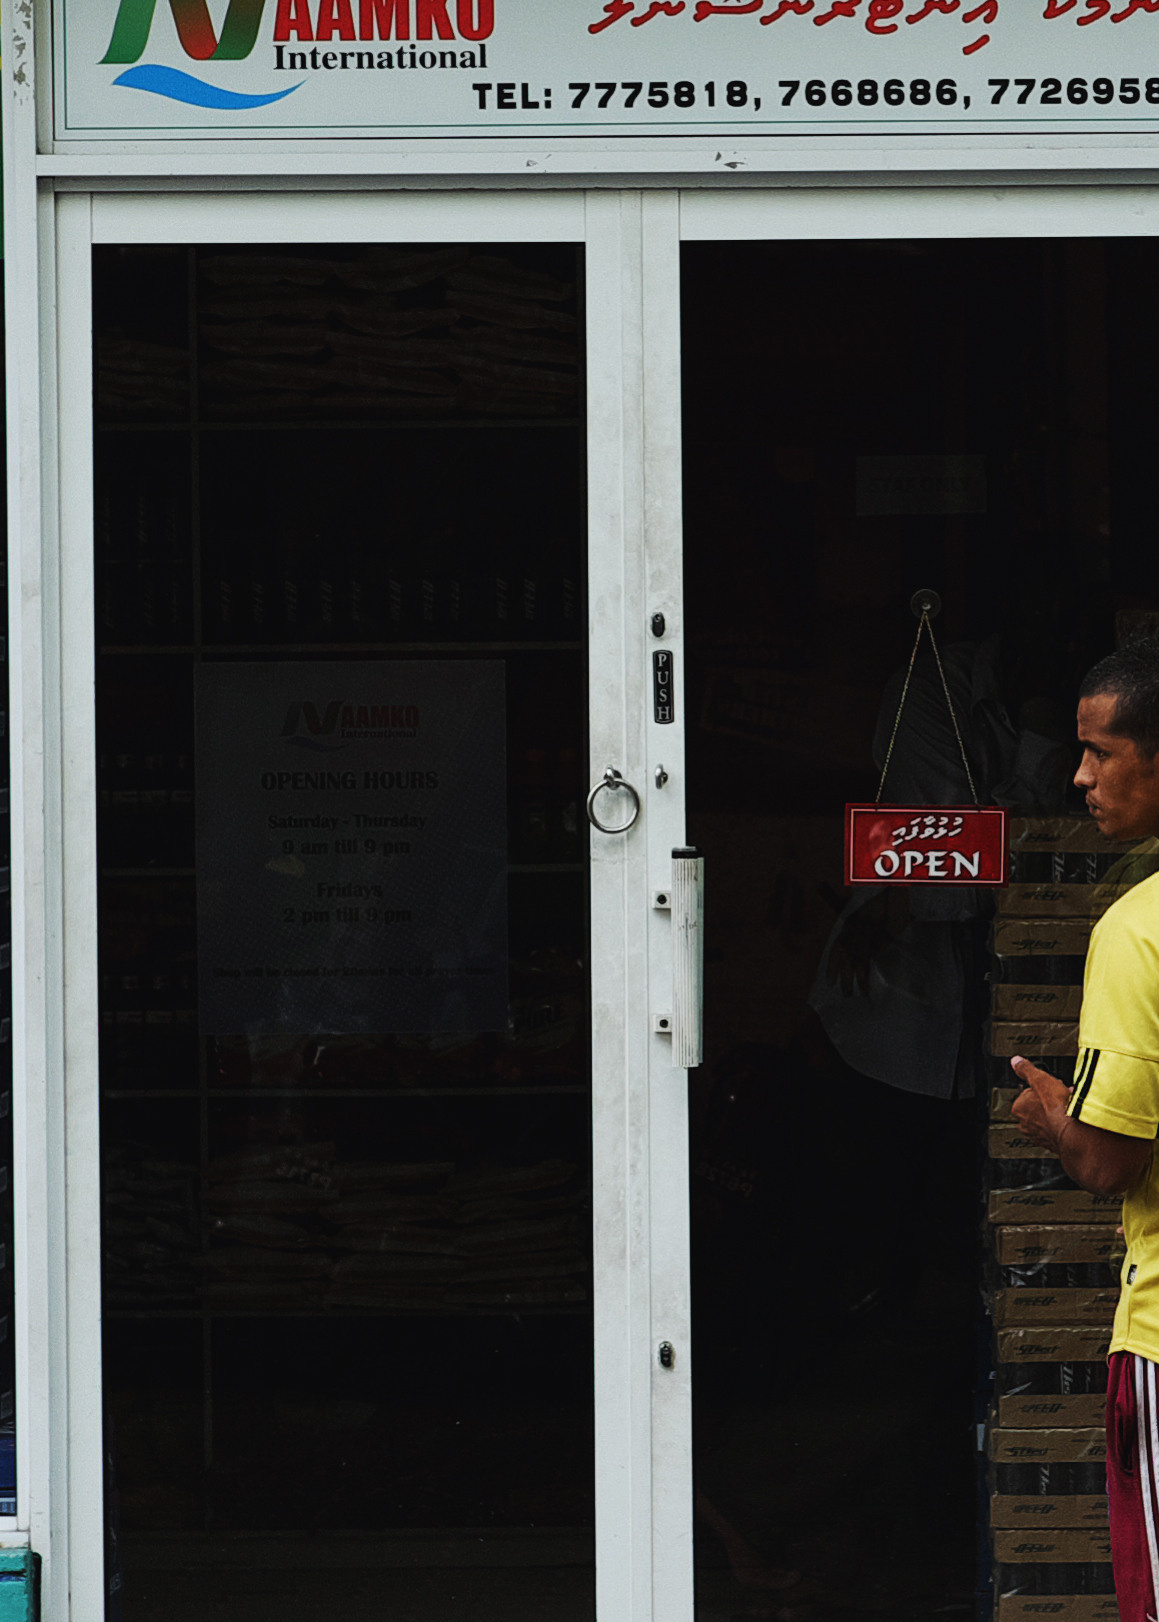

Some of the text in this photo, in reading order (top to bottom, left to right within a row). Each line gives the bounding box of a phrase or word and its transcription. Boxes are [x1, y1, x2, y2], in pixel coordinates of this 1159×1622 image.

[274, 44, 487, 70] International
[473, 83, 552, 109] TEL:
[569, 81, 760, 111] 7775818,
[779, 79, 970, 109] 7668686,
[657, 653, 670, 720] PUSH
[261, 771, 439, 790] OPENING HOURS
[268, 814, 338, 830] Saturday
[354, 814, 428, 830] Thursday
[874, 850, 980, 877] OPEN
